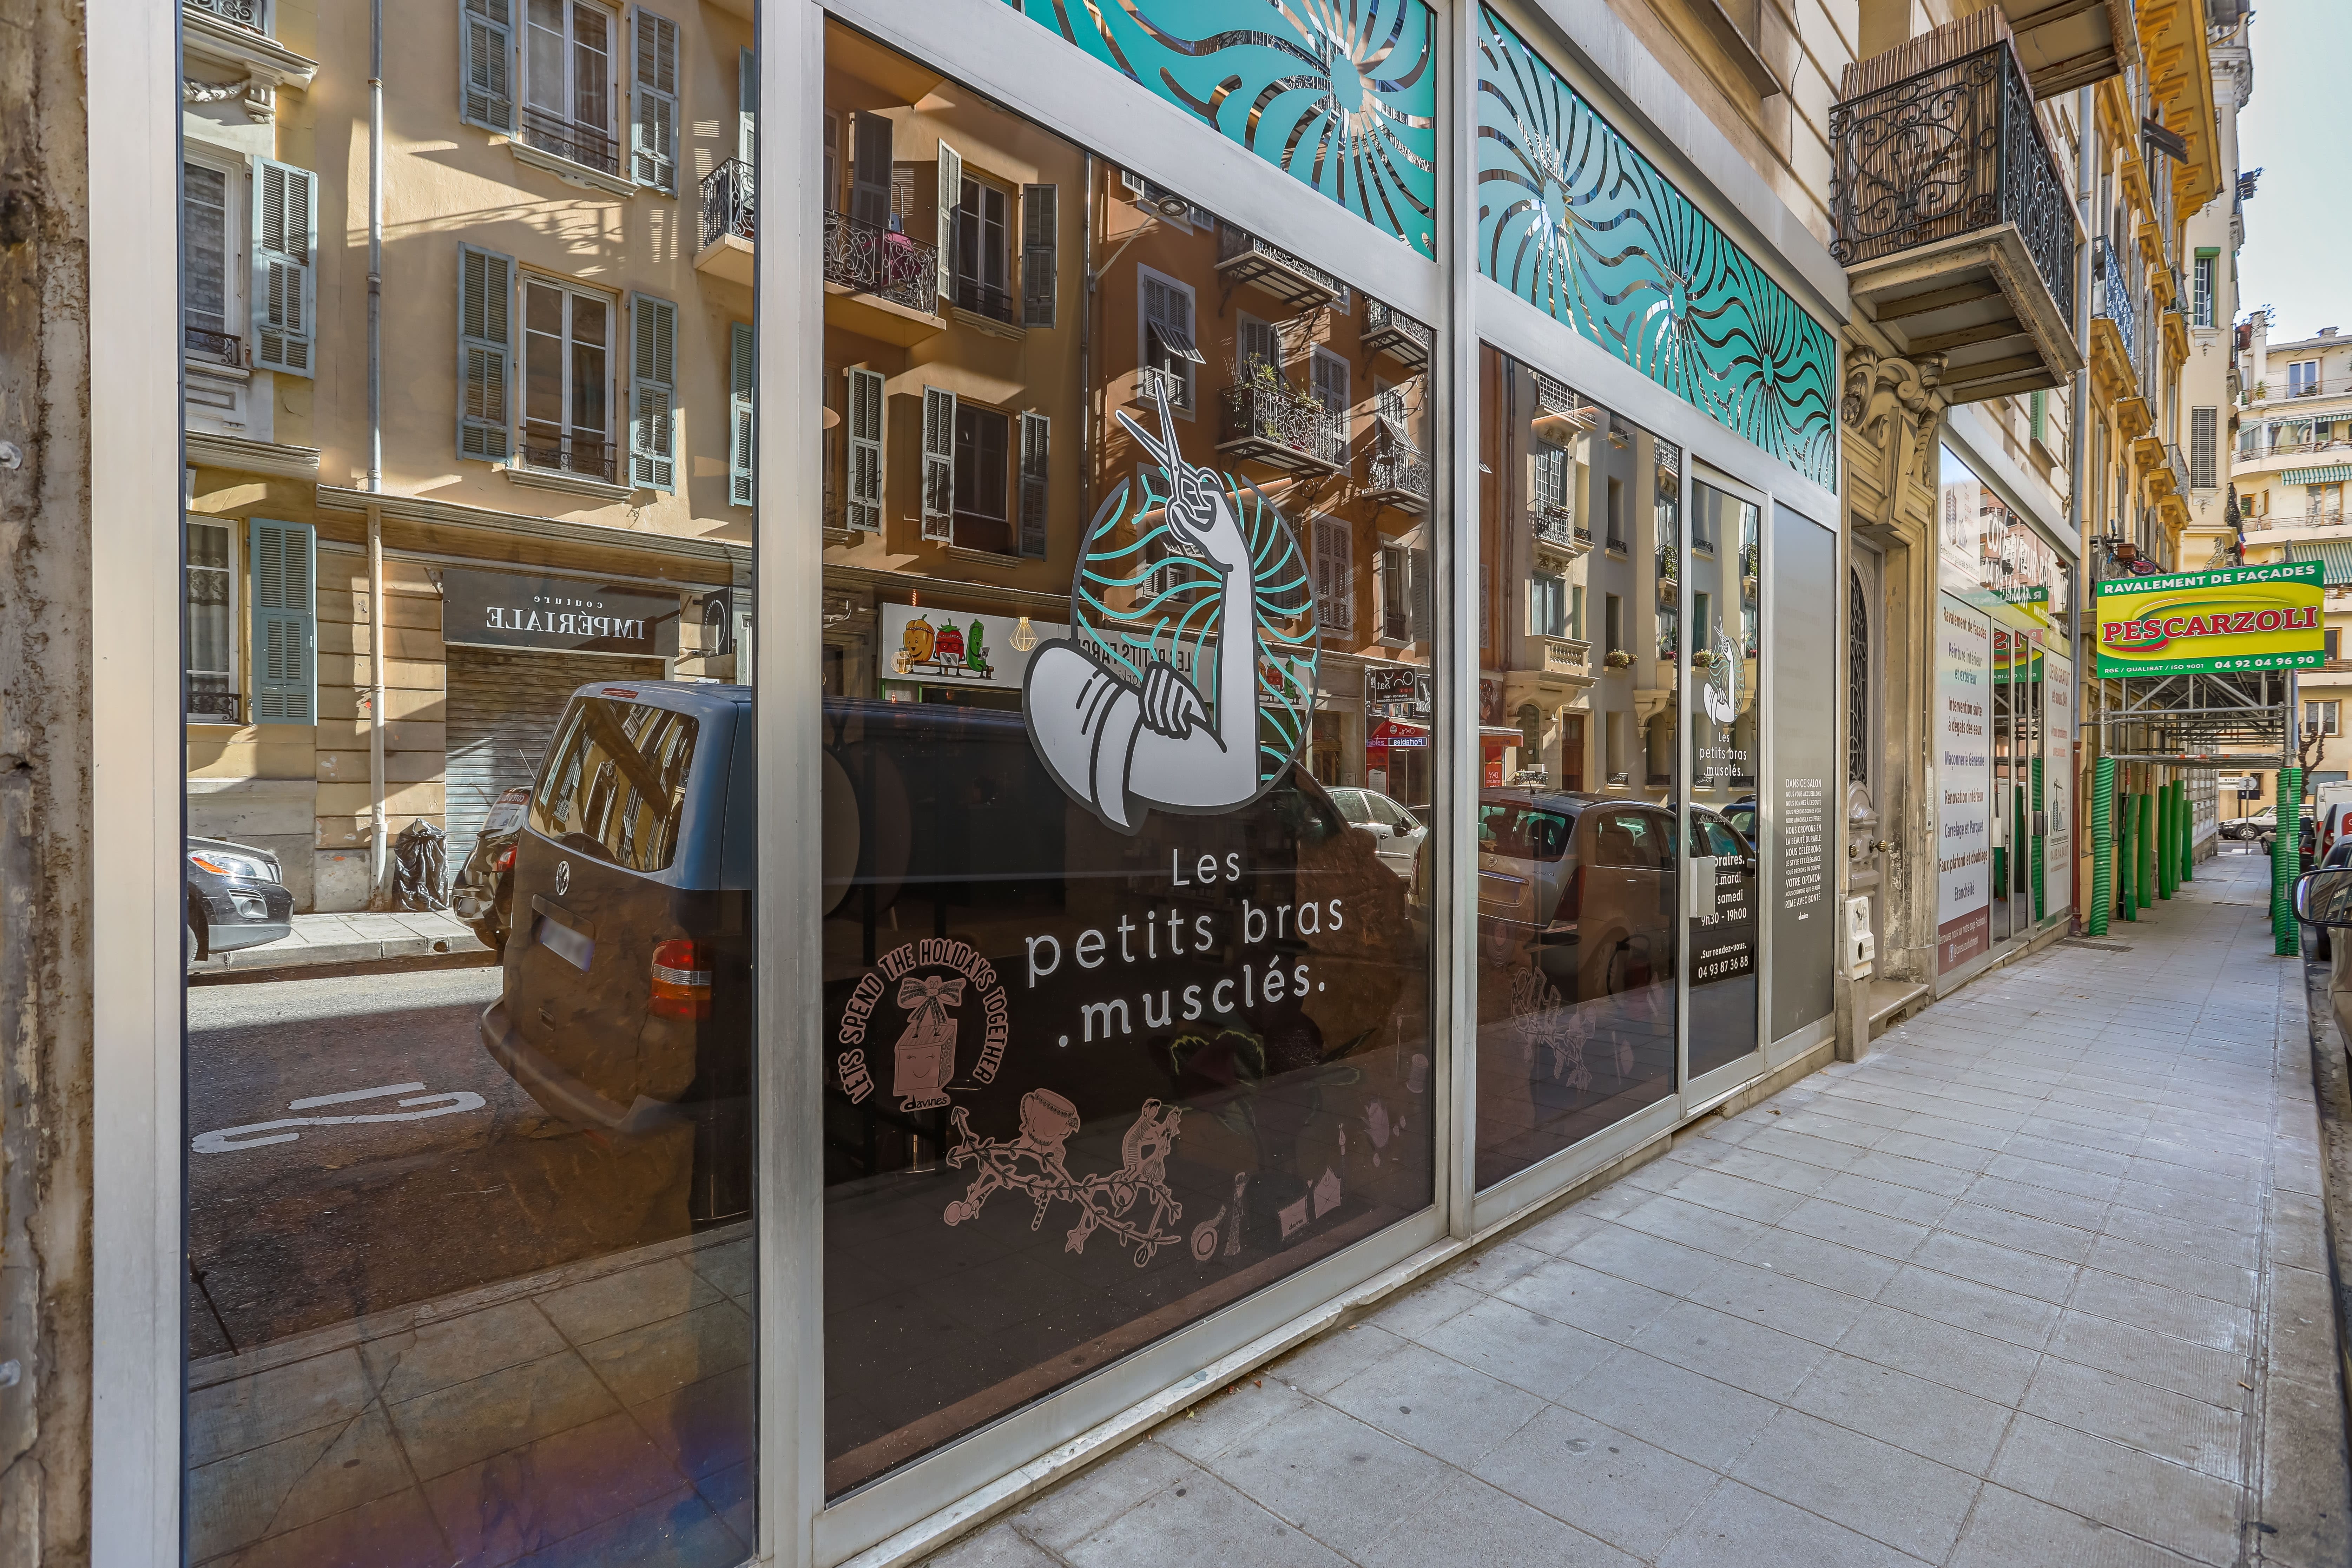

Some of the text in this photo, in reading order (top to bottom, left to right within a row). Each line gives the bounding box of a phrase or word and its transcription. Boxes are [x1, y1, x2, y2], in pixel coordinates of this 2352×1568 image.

[2104, 565, 2316, 594] RAVALEMENT DE FAÇADES
[1944, 606, 1966, 631] Ravalement
[1968, 618, 1972, 633] de
[1974, 620, 1986, 640] façades
[2102, 606, 2318, 643] PESCARZOLI
[1949, 642, 1982, 667] Peinture intérieur
[2297, 656, 2315, 664] 90
[1955, 667, 1977, 685] et extérieur
[1949, 696, 1982, 717] Intervention suite
[1949, 716, 1951, 731] à
[1952, 717, 1965, 737] dégats
[1974, 725, 1982, 736] eaux
[1719, 732, 1730, 742] Les
[1700, 746, 1747, 760] petits bras
[1945, 751, 1984, 770] Maçonnerie Générale
[1704, 764, 1743, 776] .musclés.
[1786, 778, 1821, 788] DANS CE SALON
[1945, 788, 1983, 804] Rénovation intérieur
[1786, 826, 1797, 835] NOUS
[1798, 825, 1816, 834] CROYONS
[1945, 820, 1983, 839] Carrelage et Parquet
[1791, 834, 1805, 844] BEAUTÉ
[1806, 835, 1821, 843] DURABLE
[1711, 852, 1744, 867] oraires.
[1786, 844, 1821, 857] NOUS CÉLÉBRONS
[1804, 855, 1821, 864] L'ÉLÉGANCE
[1173, 849, 1240, 887] Les
[1939, 848, 1987, 874] Faux plafond et doublage
[1721, 871, 1741, 885] mardi
[1786, 873, 1821, 888] VOTRE OPINION
[1718, 889, 1743, 904] samedi
[1785, 891, 1821, 909] RIME AVEC BONTÉ
[1701, 912, 1719, 926] 9h30
[1727, 907, 1747, 921] 19h00
[1025, 899, 1343, 989] petits bras
[1713, 942, 1746, 956] rendez-vous.
[1698, 955, 1748, 979] 04 93 87 36 88
[1058, 955, 1325, 1048] .musclés.
[840, 974, 883, 1043] SPEND
[878, 945, 915, 980] THE
[921, 940, 995, 990] HOLIDAYS
[974, 987, 1007, 1082] TOGETHER
[904, 1094, 947, 1110] davines
